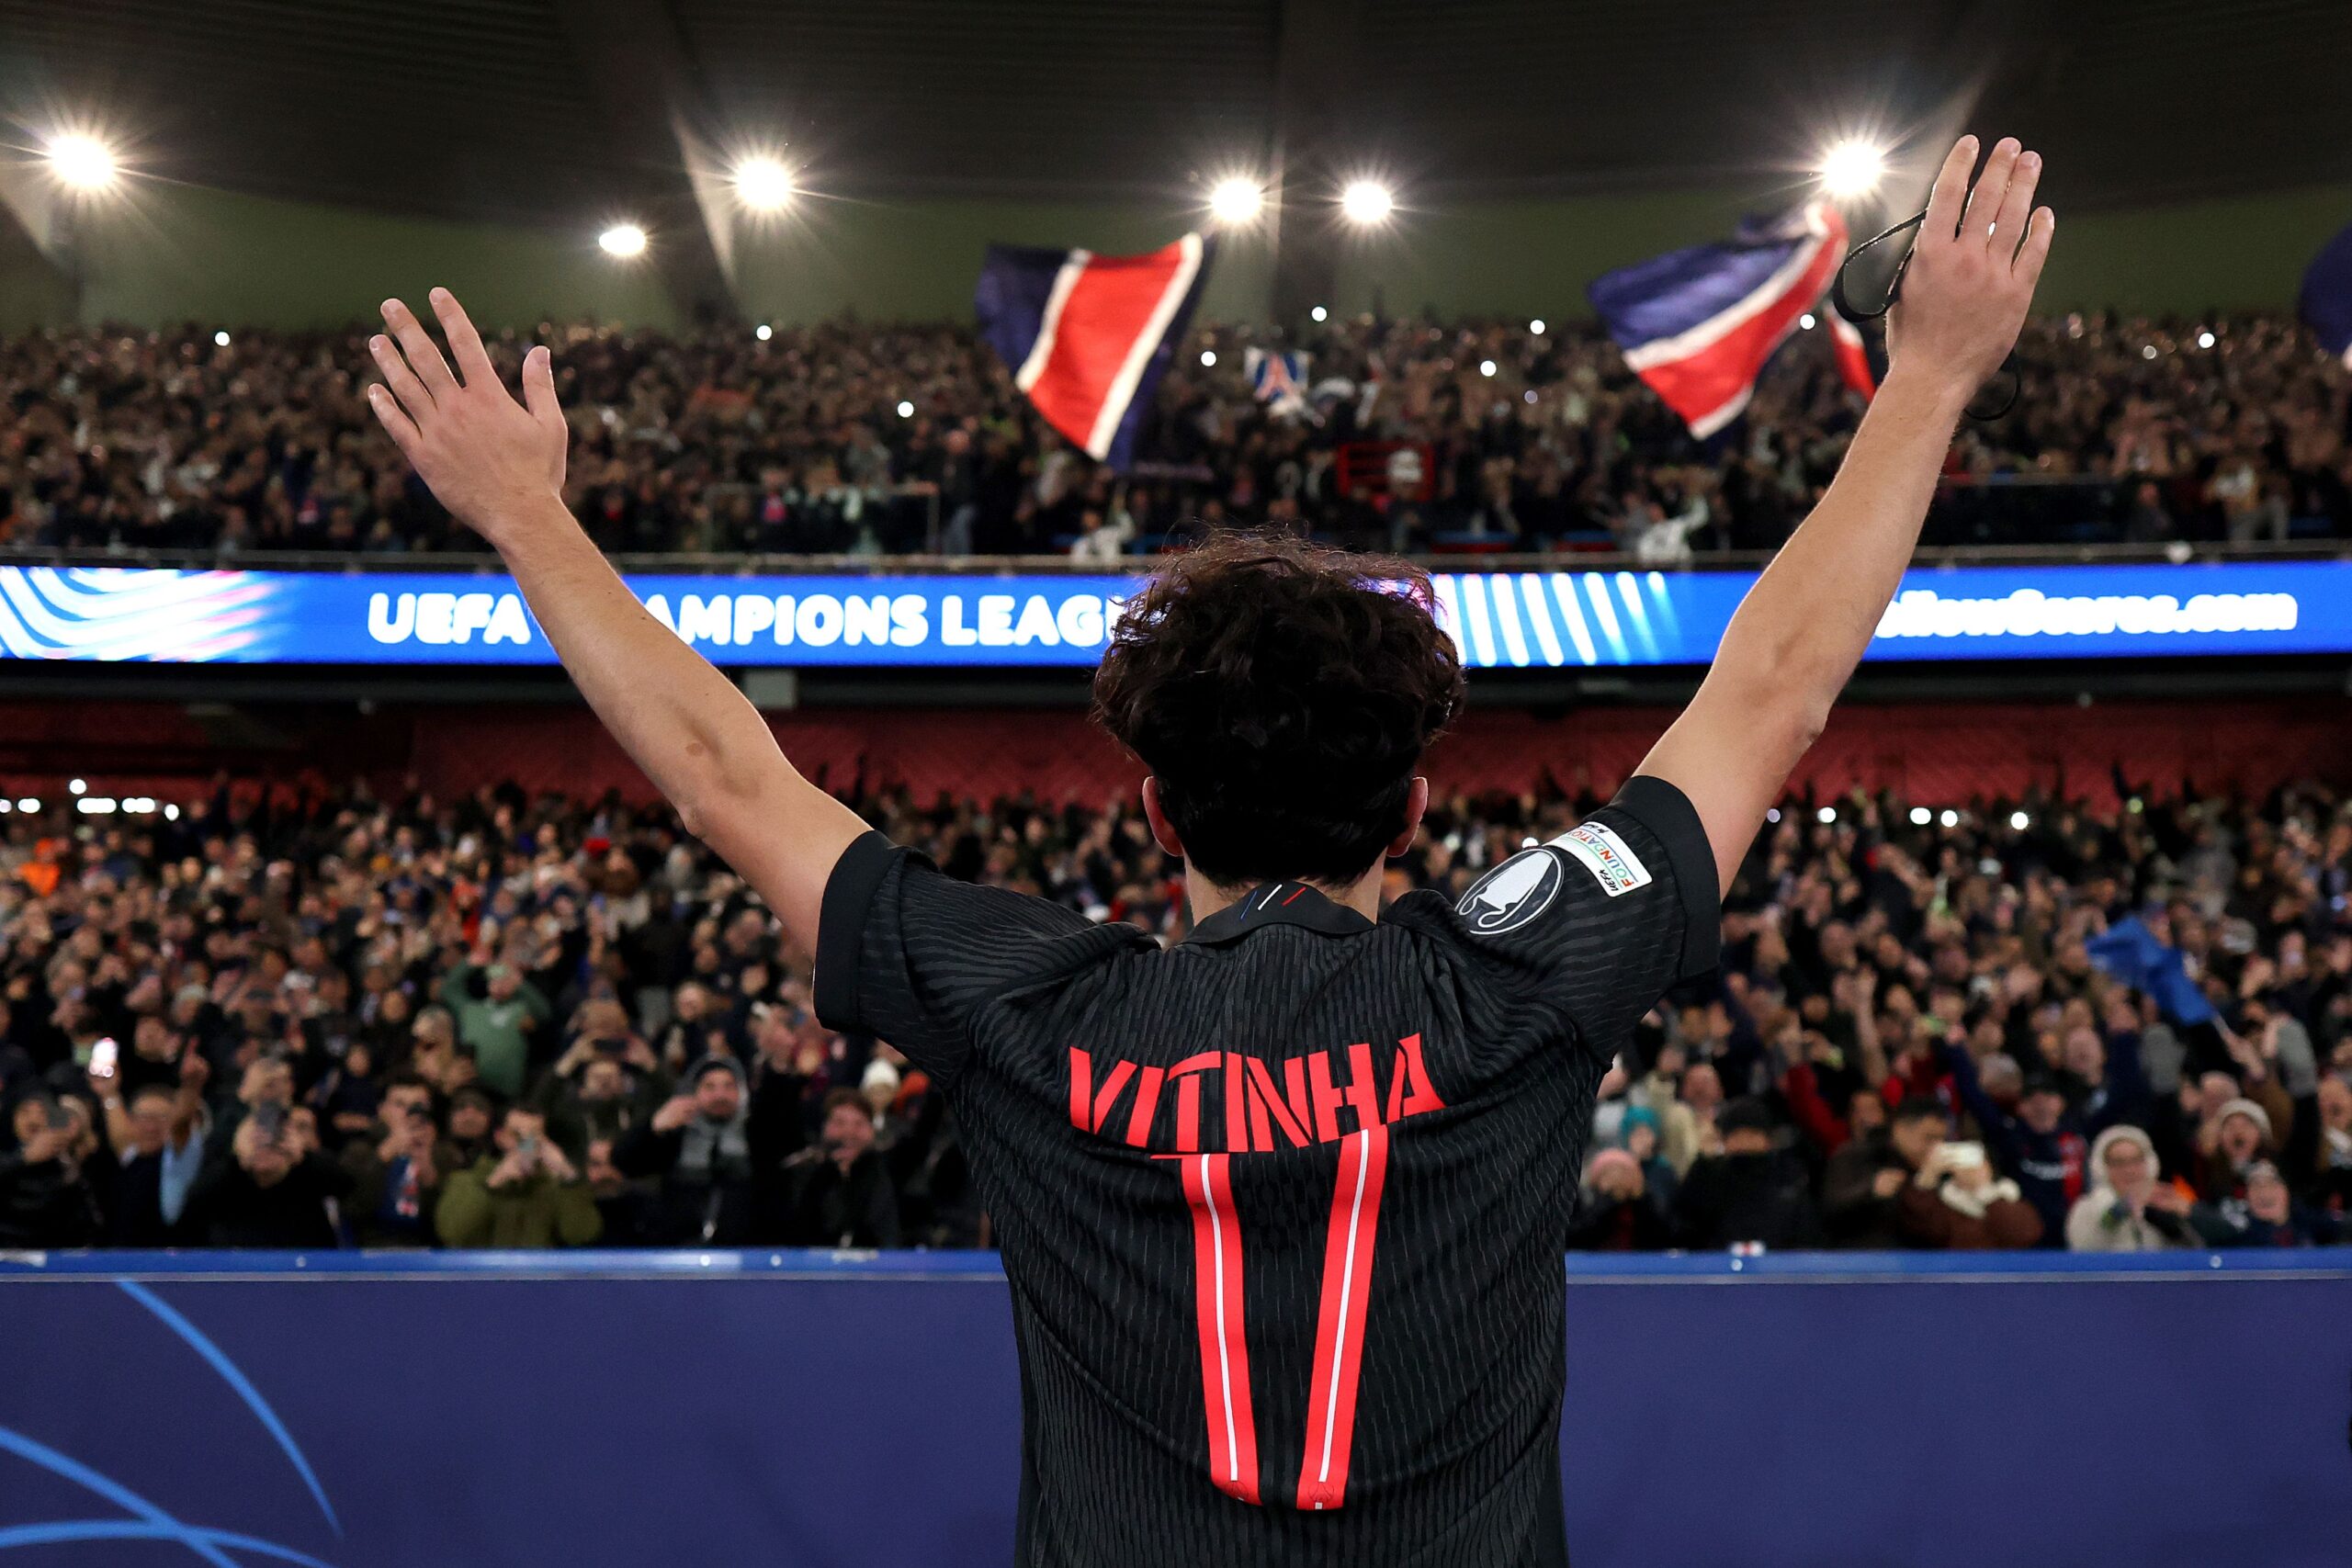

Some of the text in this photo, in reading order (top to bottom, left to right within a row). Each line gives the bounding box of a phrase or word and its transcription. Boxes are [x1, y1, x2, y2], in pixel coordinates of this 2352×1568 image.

[369, 592, 1125, 648] UEFA AMPIONS LEAG
[1599, 868, 1620, 892] UEFA
[1069, 1032, 1448, 1154] VITINHA
